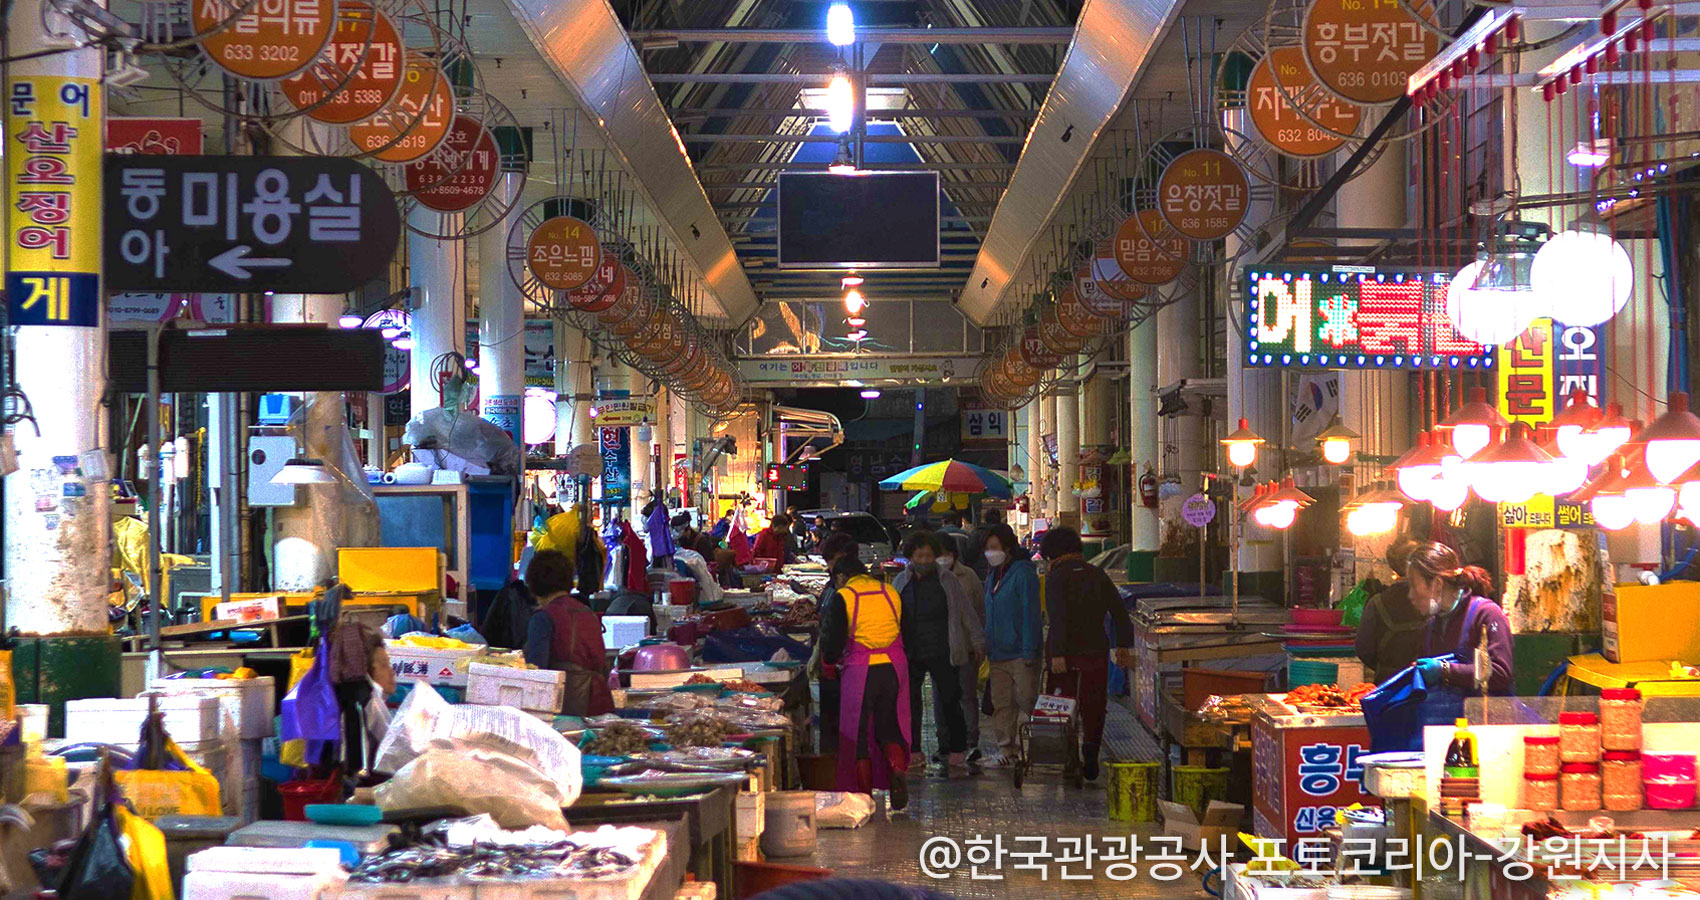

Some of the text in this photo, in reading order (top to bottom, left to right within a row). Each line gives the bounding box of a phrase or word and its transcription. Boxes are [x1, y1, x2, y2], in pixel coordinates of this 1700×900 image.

[1314, 22, 1427, 64] 흥부젓갈
[224, 44, 299, 61] 633 3202
[1281, 65, 1300, 75] No.
[1338, 71, 1408, 87] 636 0103
[300, 89, 382, 105] 011 93 5388
[367, 136, 390, 148] 636
[1278, 129, 1302, 142] 632
[1184, 160, 1221, 177] No. 11
[15, 122, 78, 260] 산오징어
[421, 186, 485, 195] 0-8609-4678
[1166, 184, 1242, 212] 은창젓갈
[182, 168, 363, 245] 미용실
[1182, 217, 1229, 229] 636 1585
[564, 226, 580, 239] 14
[533, 244, 595, 268] 조은느낌
[545, 272, 560, 281] 632
[1133, 267, 1149, 276] 632
[21, 277, 71, 321] 게
[1503, 506, 1527, 525] 삶아
[1557, 505, 1582, 525] 썰어
